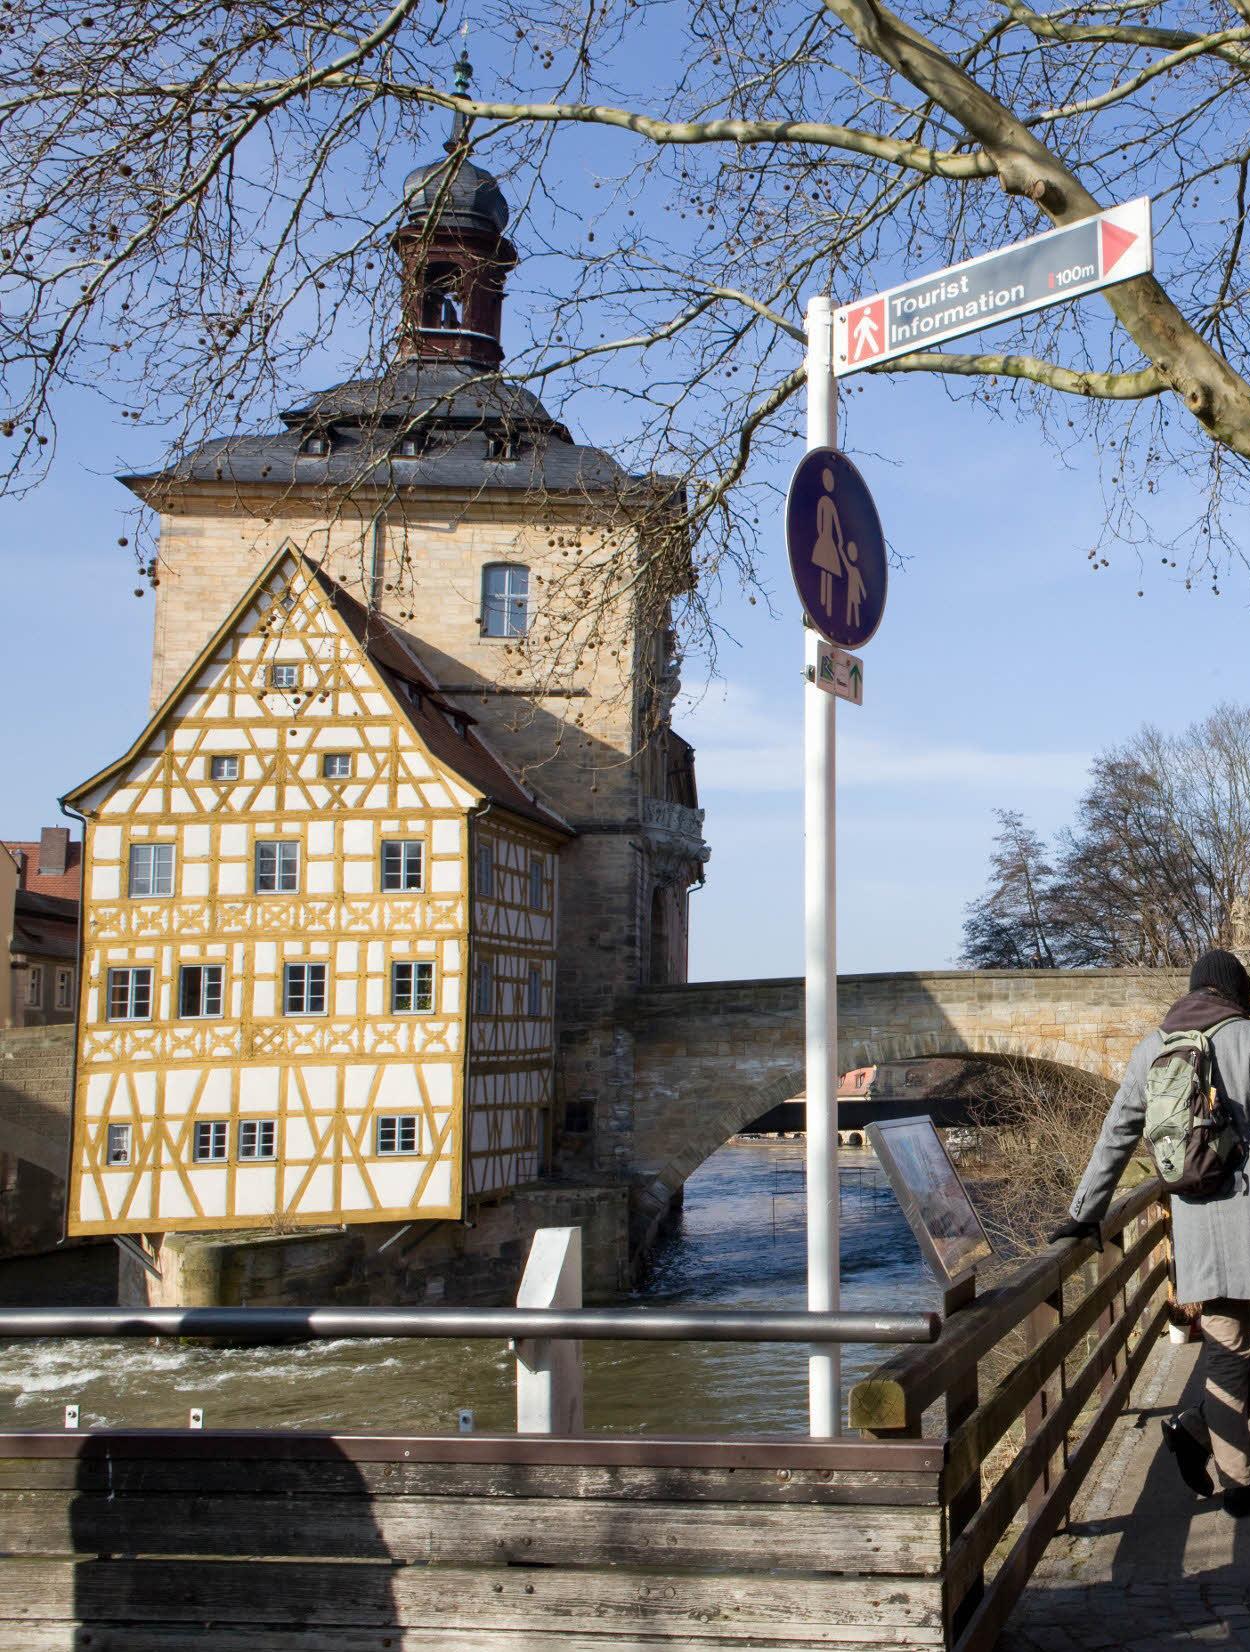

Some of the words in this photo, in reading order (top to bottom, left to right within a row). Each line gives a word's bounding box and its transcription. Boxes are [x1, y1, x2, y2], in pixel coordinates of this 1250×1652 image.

[892, 275, 969, 318] Tourist
[1055, 263, 1095, 287] 100m
[891, 284, 1025, 343] Information
